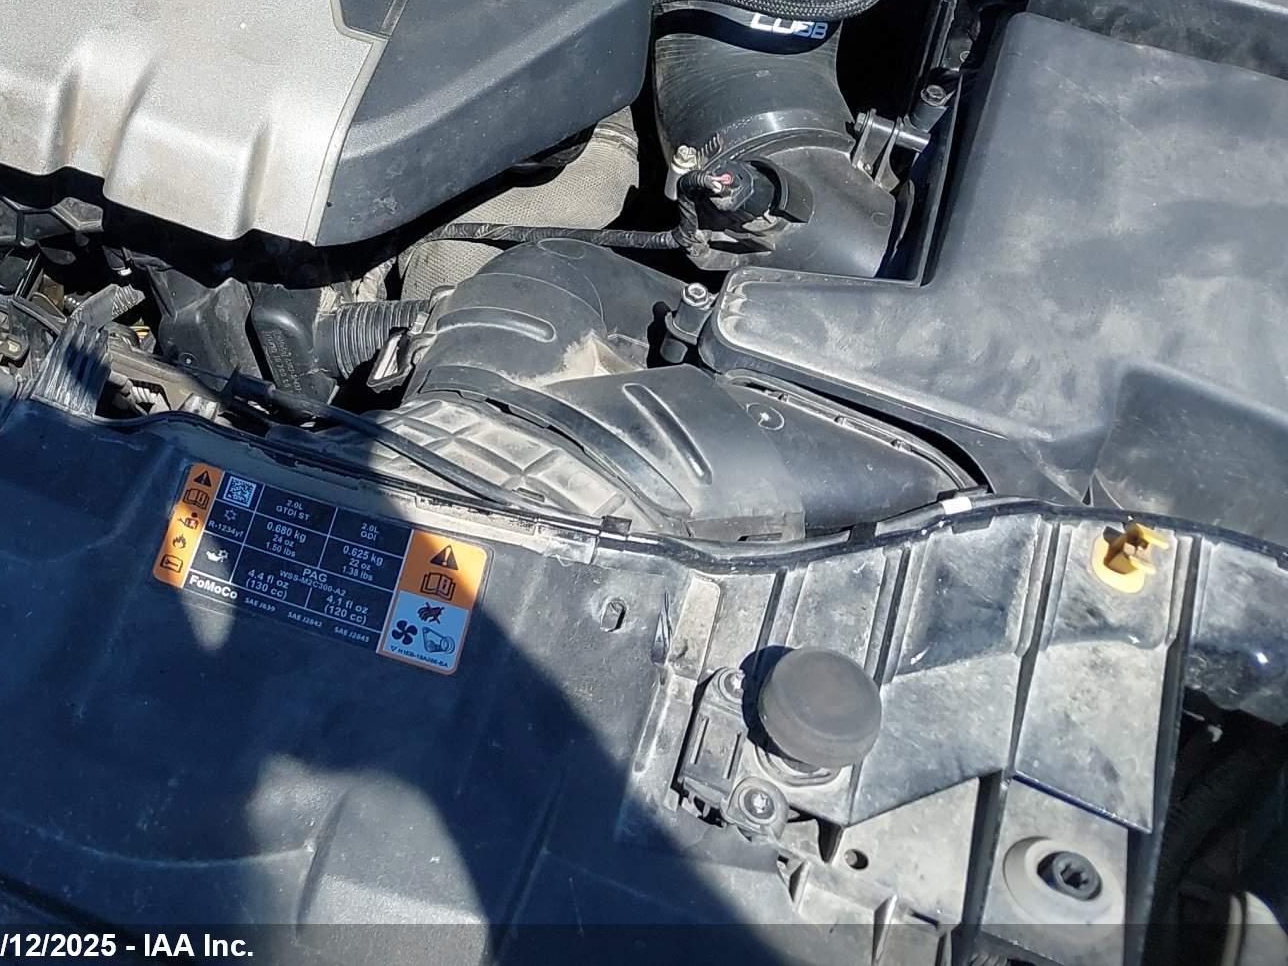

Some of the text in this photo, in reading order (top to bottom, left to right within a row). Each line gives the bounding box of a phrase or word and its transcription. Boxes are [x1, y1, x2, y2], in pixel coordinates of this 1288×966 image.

[286, 499, 304, 510] 2.0L
[276, 505, 310, 521] GTDI ST
[208, 520, 244, 538] R-1234yf
[267, 521, 307, 543] 0.680 kg
[361, 522, 379, 534] 2.0L
[272, 534, 295, 547] 24 oz
[360, 530, 377, 542] GDI
[265, 541, 296, 558] 1.50 lbs
[342, 545, 384, 567] 0.625 kg
[349, 558, 372, 571] 22 oz
[247, 569, 290, 589] 4.4 fl oz
[302, 568, 328, 583] PAG
[342, 566, 373, 581] 1.38 lbs
[189, 574, 238, 600] FoMoCo
[245, 578, 288, 601] (130 cc)
[244, 597, 259, 607] SAE
[326, 594, 369, 615] 4.1 fl oz
[287, 611, 301, 621] SAE
[324, 603, 367, 626] (120 cc)
[334, 626, 348, 636] SAE
